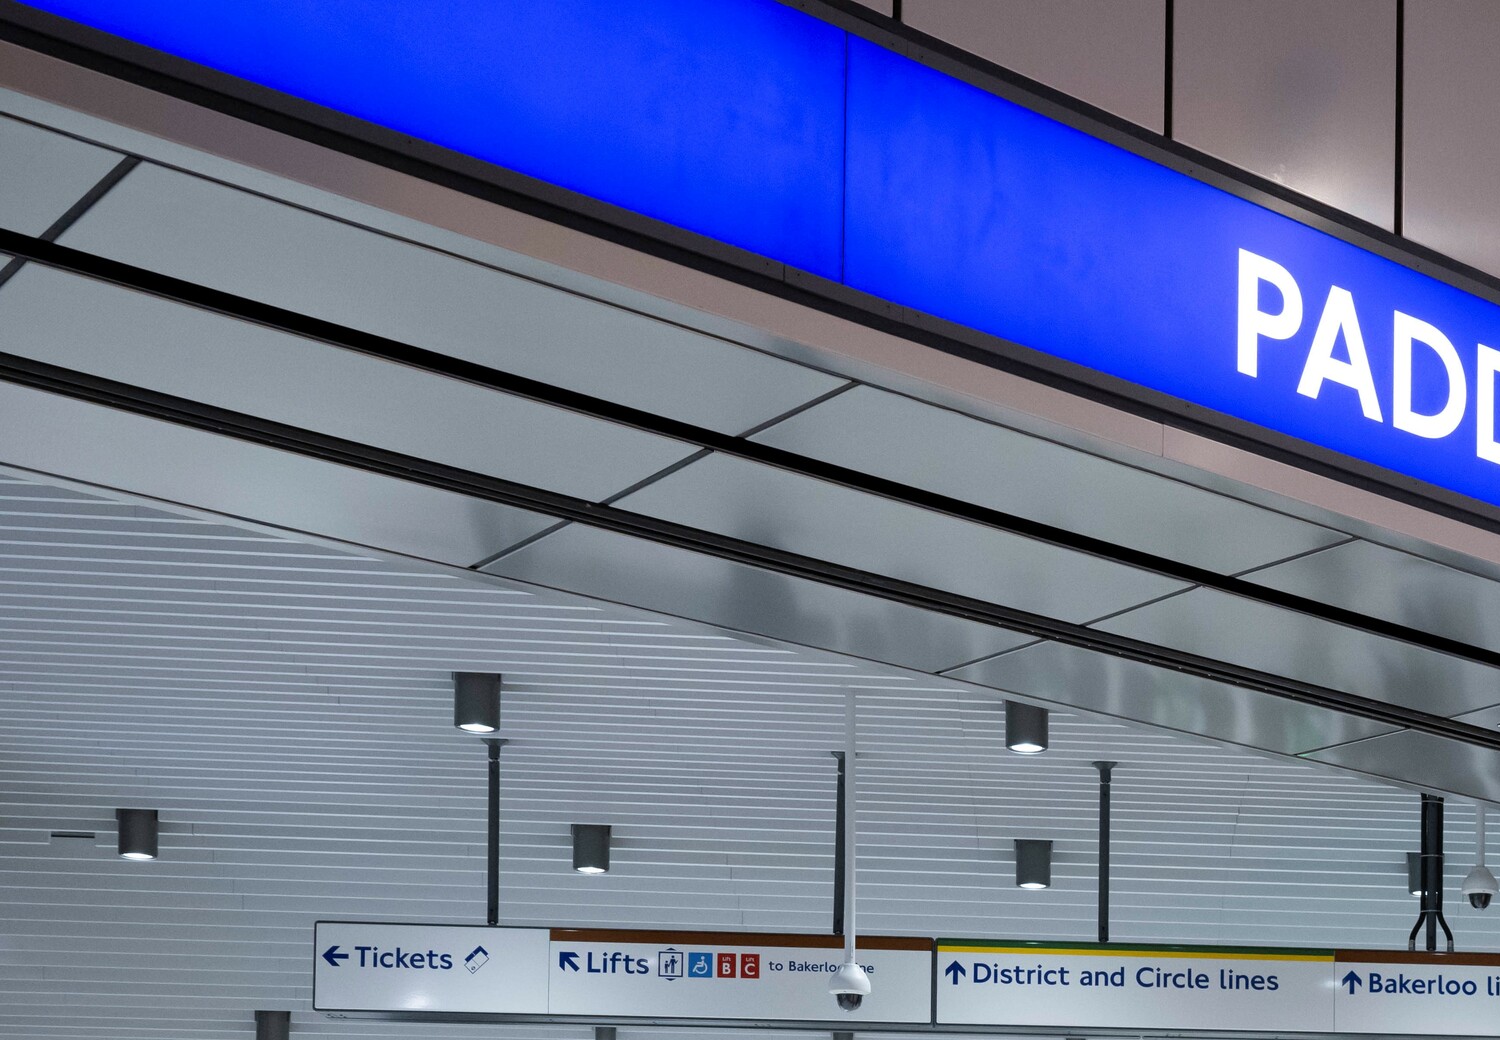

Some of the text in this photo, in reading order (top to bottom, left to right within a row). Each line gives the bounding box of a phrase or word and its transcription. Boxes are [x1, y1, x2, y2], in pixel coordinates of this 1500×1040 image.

[354, 946, 453, 970] Tickets
[587, 951, 650, 975] Lifts
[722, 963, 731, 975] B
[744, 963, 755, 976] C
[769, 960, 783, 971] to
[973, 962, 1279, 991] District and Circle lines
[1369, 973, 1477, 996] Bakerloo
